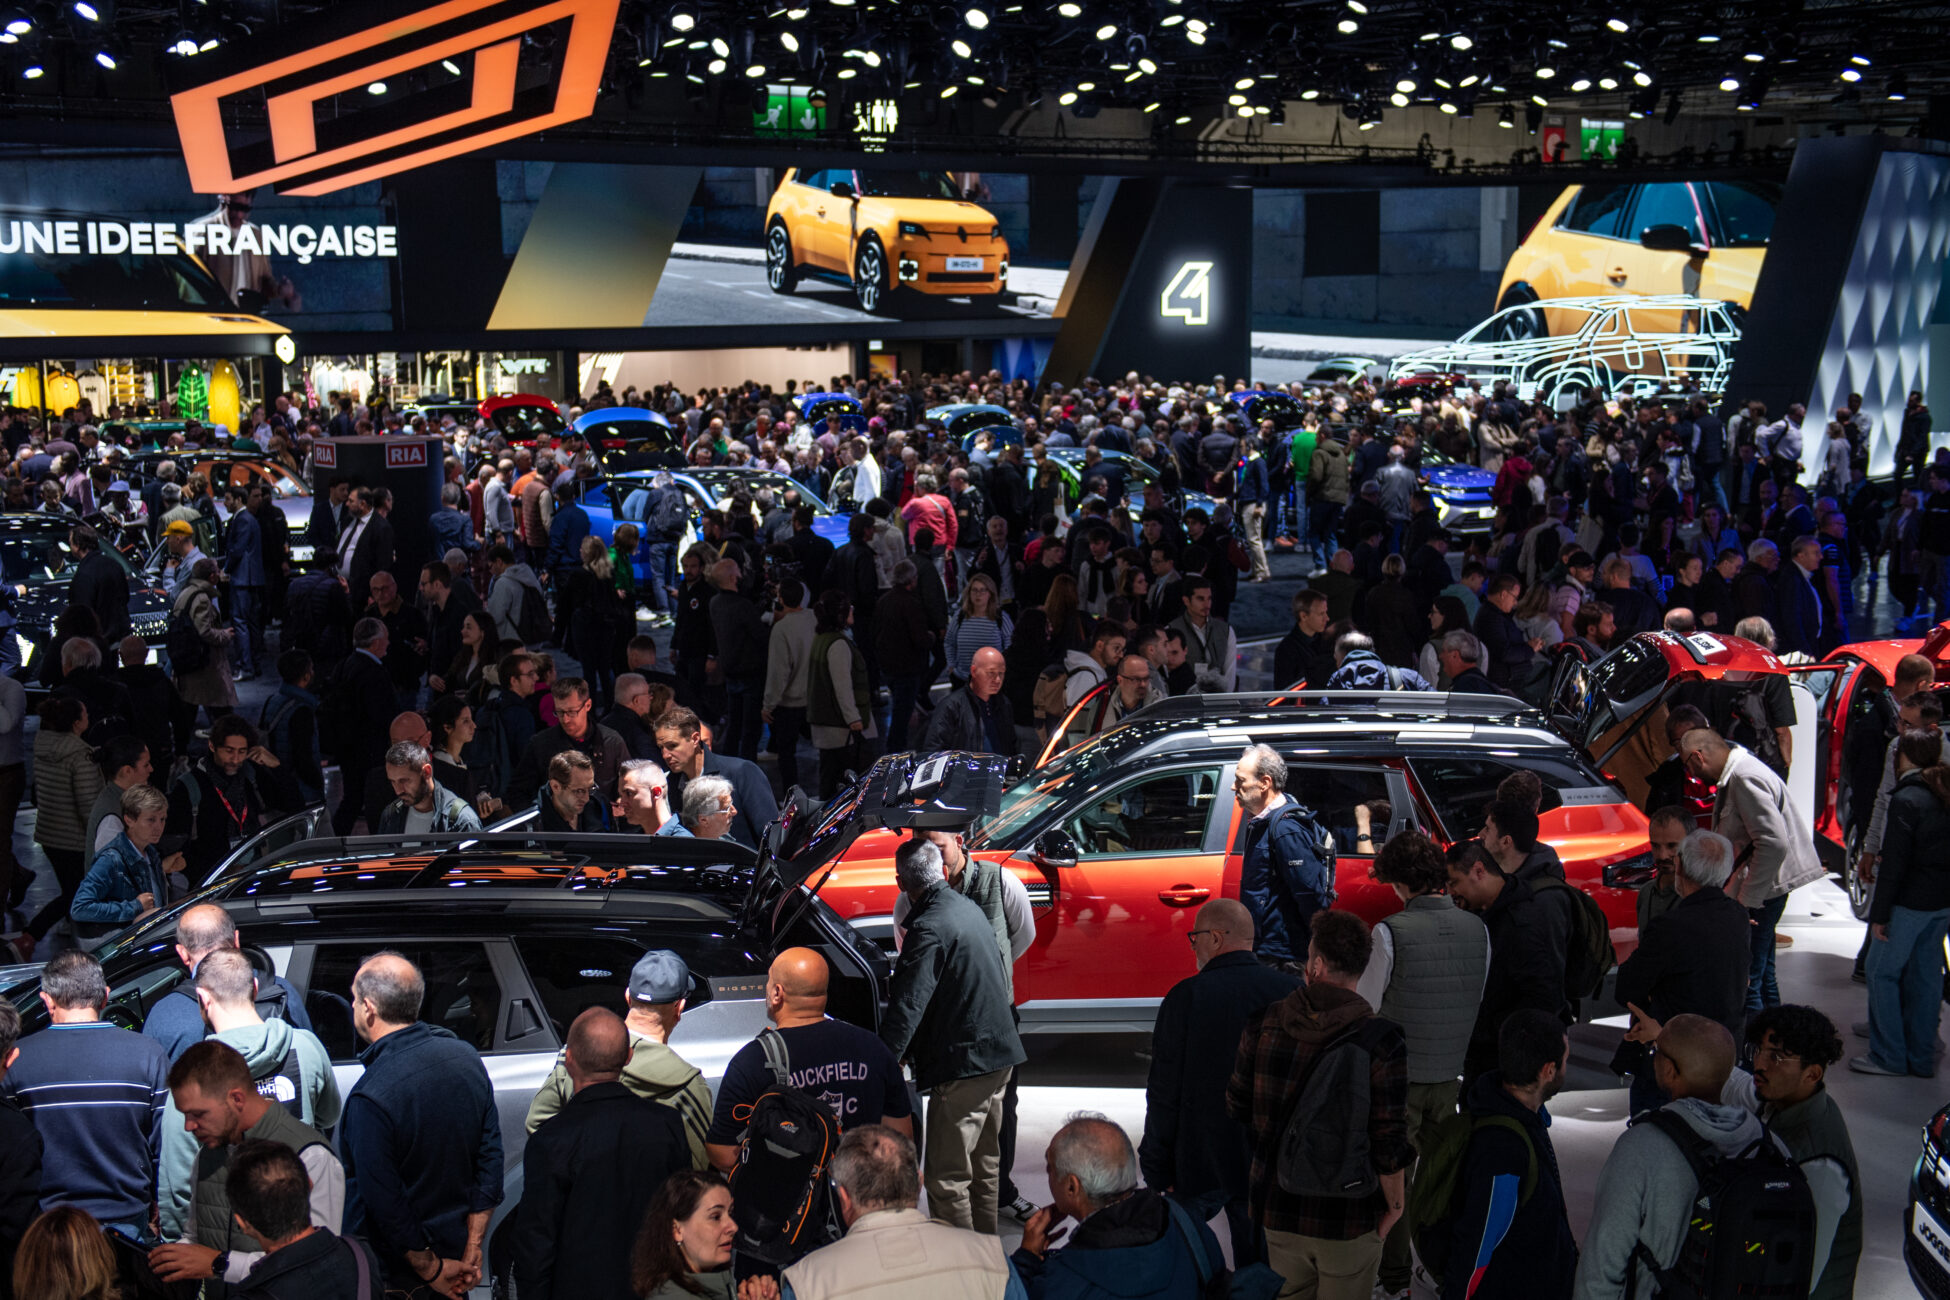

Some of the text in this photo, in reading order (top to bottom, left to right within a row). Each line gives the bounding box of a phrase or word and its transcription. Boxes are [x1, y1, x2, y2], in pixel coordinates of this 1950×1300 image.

[0, 221, 398, 264] UNE IDEE FRANÇAISE
[1161, 261, 1214, 326] 4
[316, 447, 333, 463] RIA
[390, 446, 421, 463] RIA
